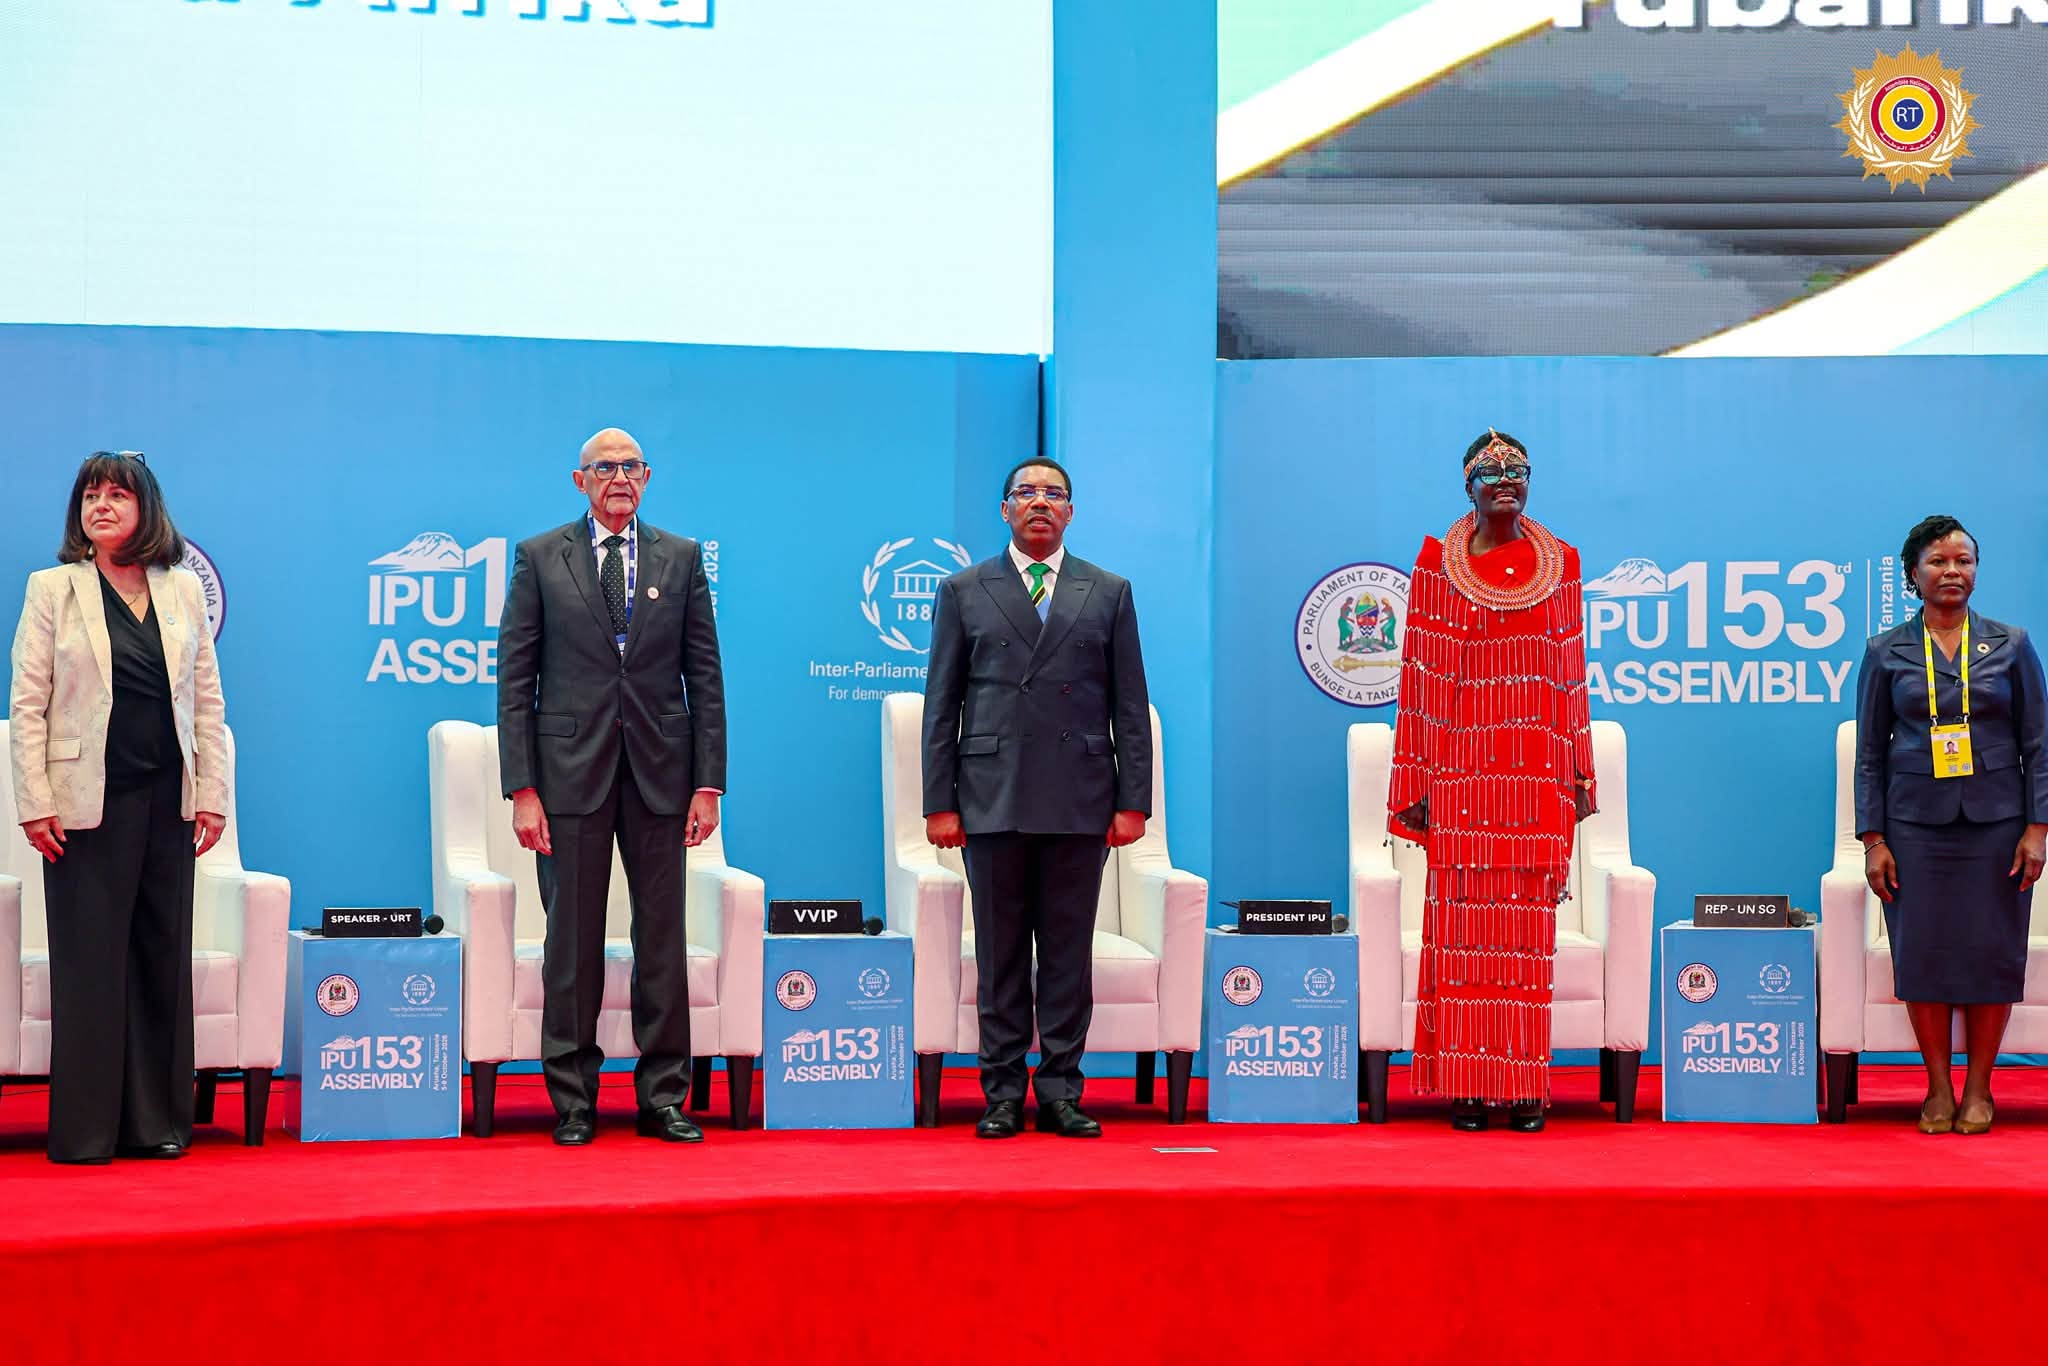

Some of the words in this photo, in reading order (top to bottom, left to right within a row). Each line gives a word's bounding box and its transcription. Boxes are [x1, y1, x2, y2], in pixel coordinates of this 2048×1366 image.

[703, 540, 719, 583] 2026
[182, 549, 217, 608] ANZANIA
[368, 576, 466, 627] IPU
[1303, 570, 1364, 635] PARLIAMENT
[1369, 570, 1389, 583] OF
[1878, 556, 1894, 634] Tanzania
[897, 604, 931, 621] 188
[1583, 601, 1669, 649] PU
[366, 639, 498, 685] ASSE
[809, 660, 928, 679] Inter-Parliame
[1310, 662, 1346, 696] BUNGE
[1347, 688, 1362, 701] LA
[1366, 685, 1399, 701] TANZ
[1586, 660, 1853, 704] ASSEMBLY
[828, 685, 848, 701] For
[331, 914, 380, 923] SPEAKER
[390, 913, 412, 923] URT
[793, 909, 838, 923] VVIP
[1246, 913, 1305, 922] PRESIDENT
[1308, 913, 1326, 922] IPU
[1705, 904, 1728, 914] REP
[1737, 904, 1755, 914] UN
[1758, 904, 1776, 914] SG
[782, 1044, 816, 1063] IPU
[1225, 1039, 1260, 1057] IPU
[1682, 1035, 1716, 1054] IPU
[320, 1050, 356, 1070] IPU
[1225, 1061, 1325, 1078] ASSEMBLY
[1682, 1058, 1783, 1073] ASSEMBLY
[320, 1072, 425, 1090] ASSEMBLY
[783, 1063, 882, 1083] ASSEMBLY
